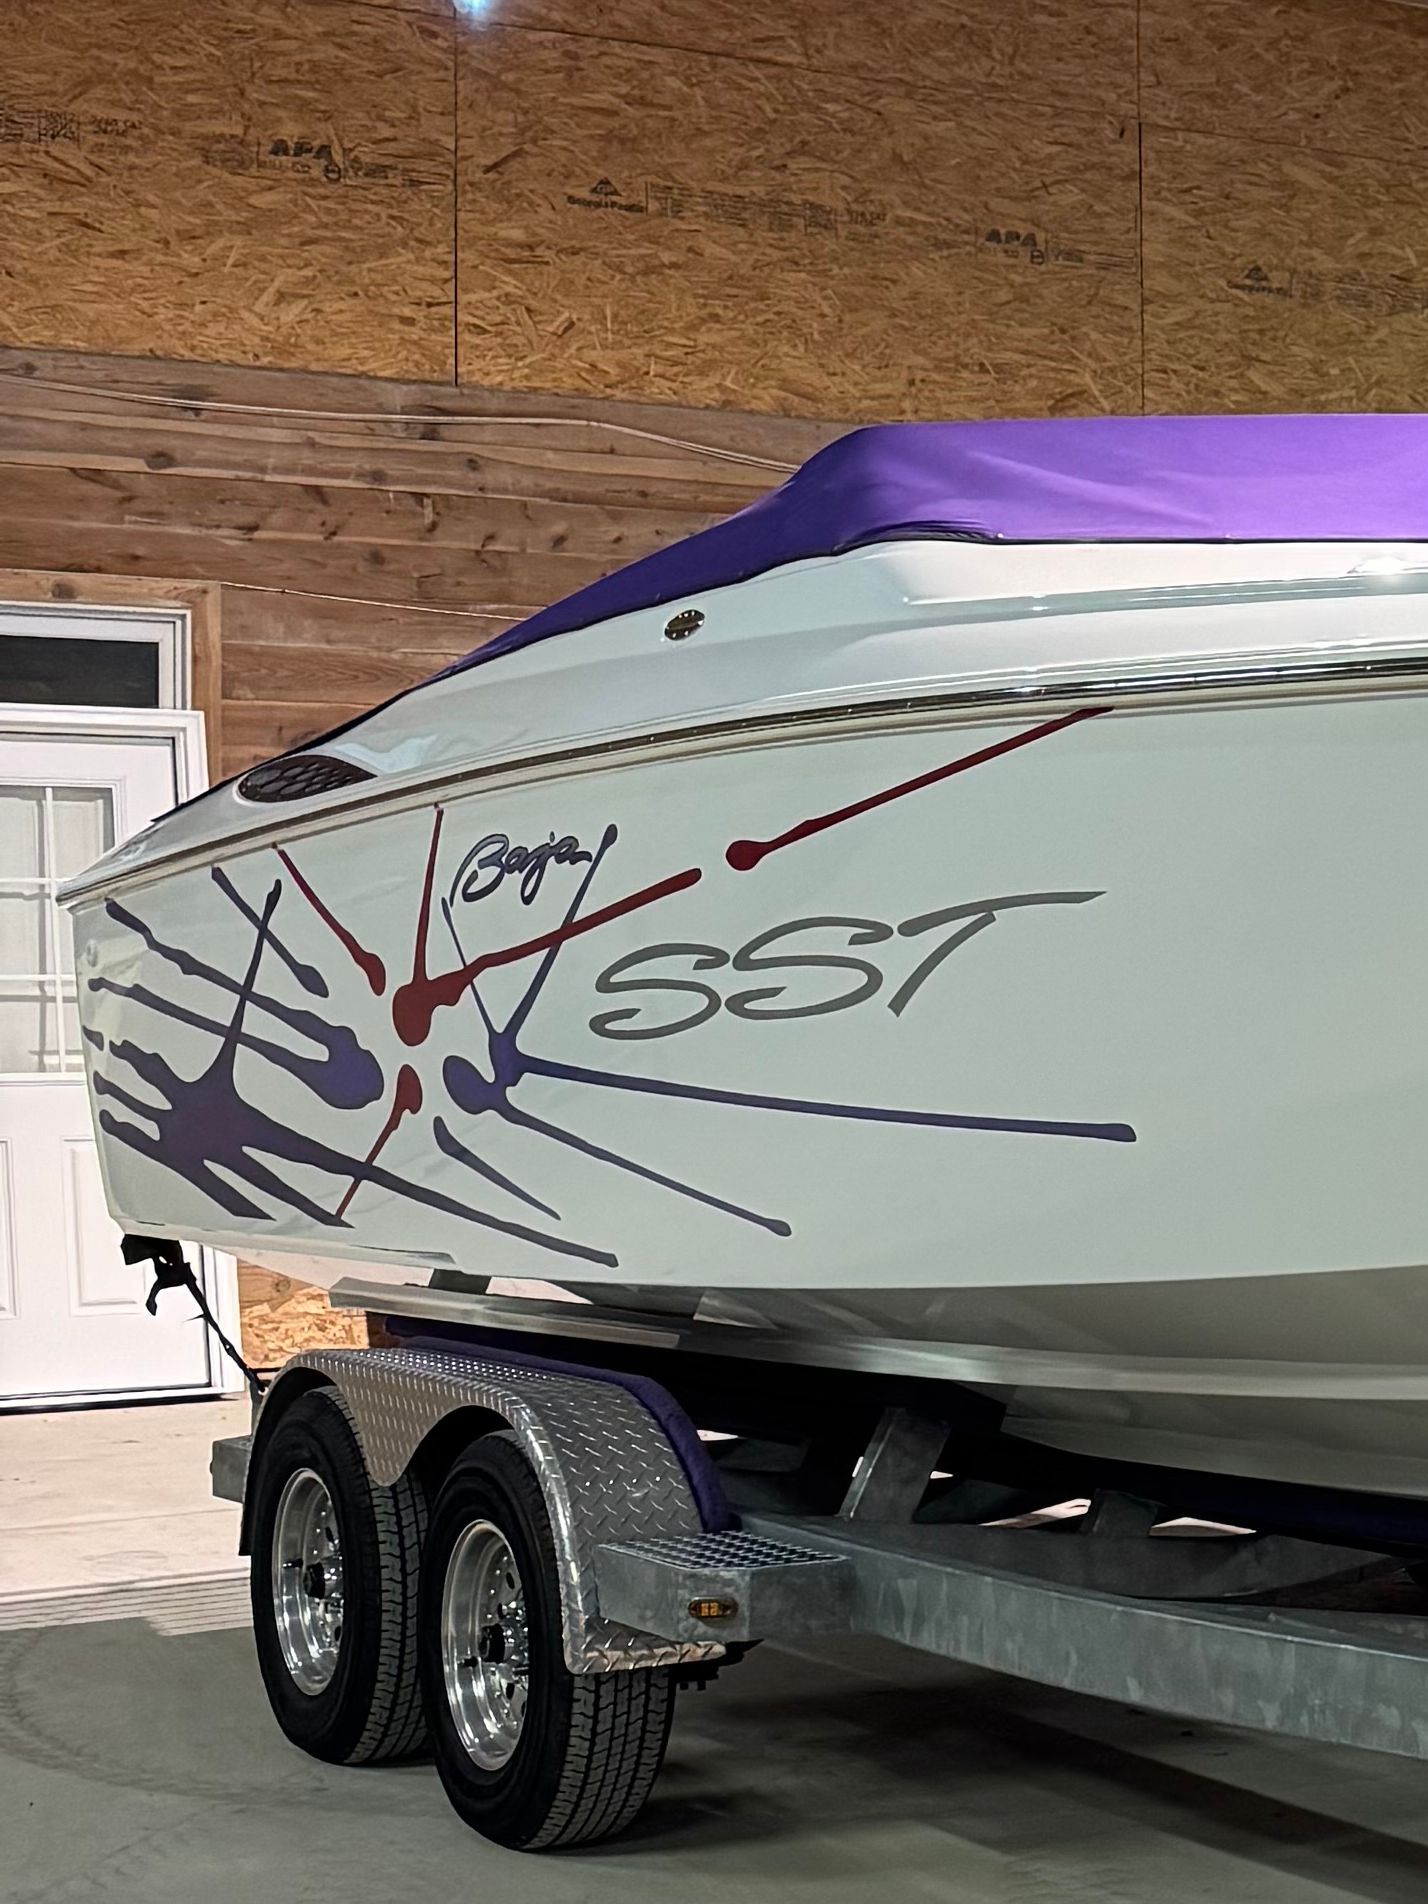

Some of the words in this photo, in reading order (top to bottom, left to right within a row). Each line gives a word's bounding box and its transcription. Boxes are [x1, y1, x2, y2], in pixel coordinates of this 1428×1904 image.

[270, 138, 333, 161] APA
[985, 228, 1038, 247] APA
[449, 831, 593, 908] Baja
[589, 891, 1107, 1040] SST
